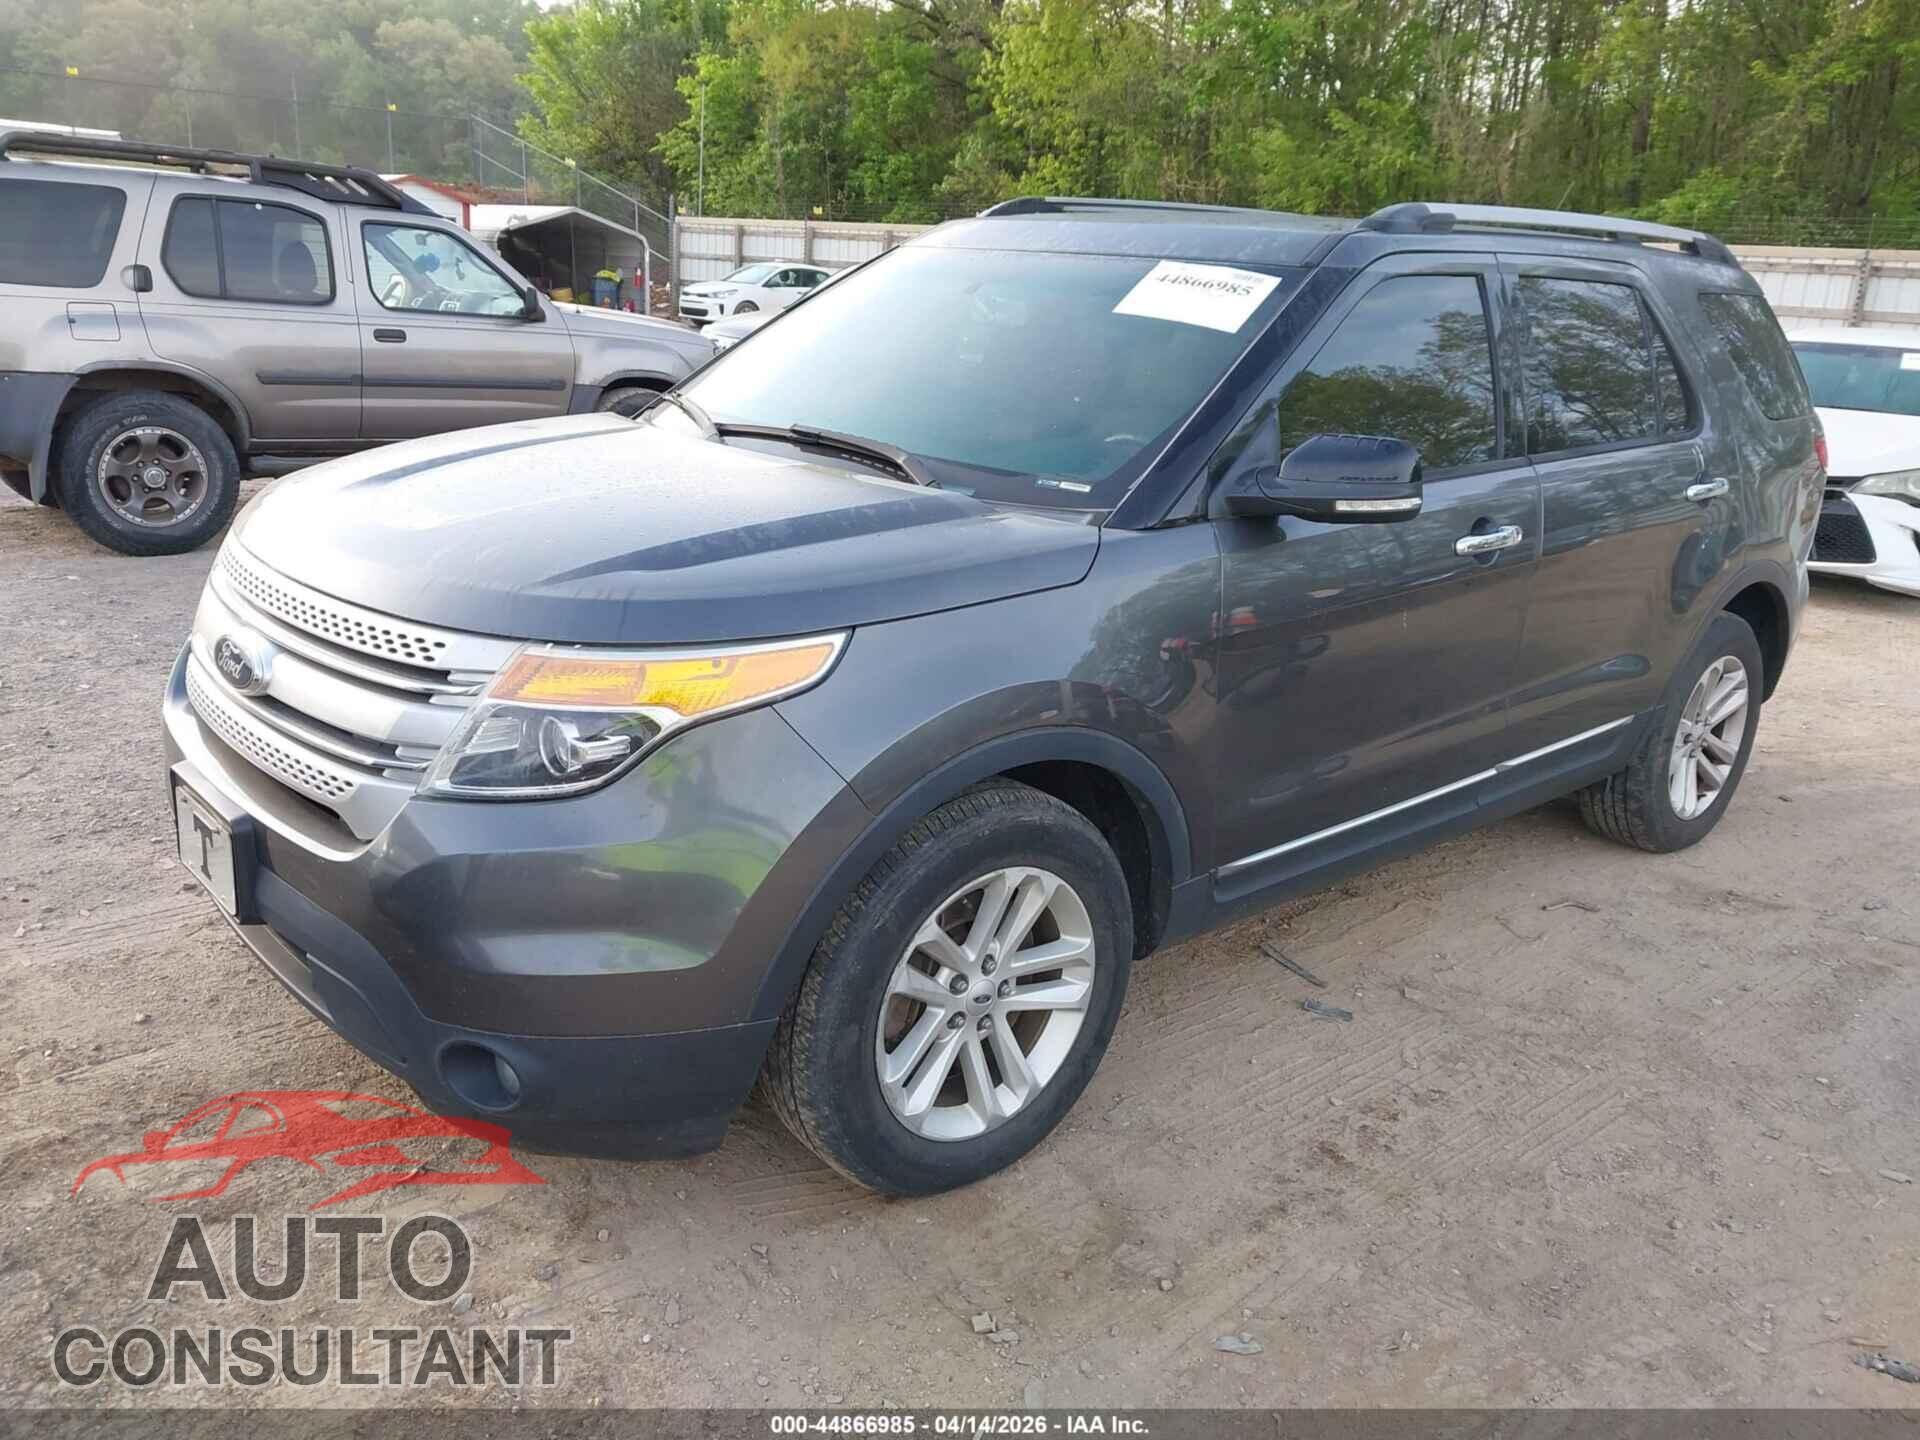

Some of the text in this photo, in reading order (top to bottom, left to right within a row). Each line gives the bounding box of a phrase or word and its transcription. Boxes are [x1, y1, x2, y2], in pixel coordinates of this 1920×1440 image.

[1157, 273, 1255, 297] 44866985
[217, 640, 246, 680] Ford
[192, 812, 215, 881] T
